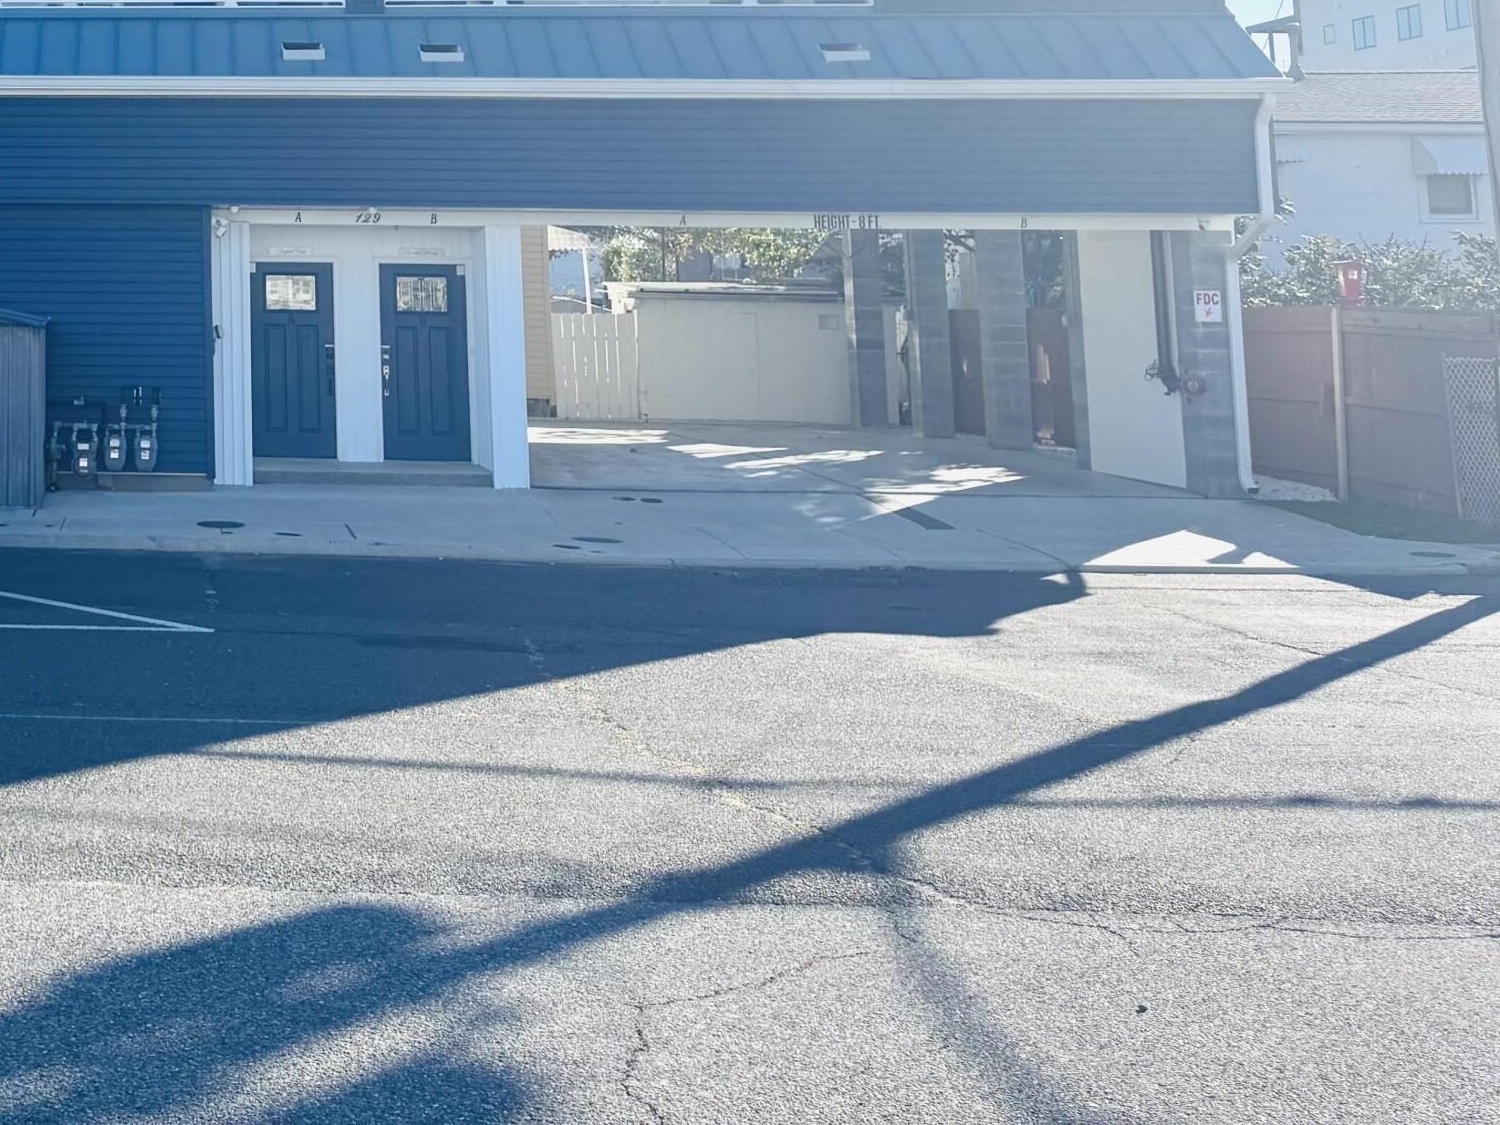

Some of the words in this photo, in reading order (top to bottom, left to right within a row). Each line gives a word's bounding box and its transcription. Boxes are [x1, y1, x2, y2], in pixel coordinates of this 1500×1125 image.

[294, 211, 302, 223] A
[355, 212, 381, 224] 129
[430, 213, 438, 225] B
[813, 214, 850, 229] HEIGHT
[858, 214, 866, 229] 8
[1195, 292, 1219, 306] FDC
